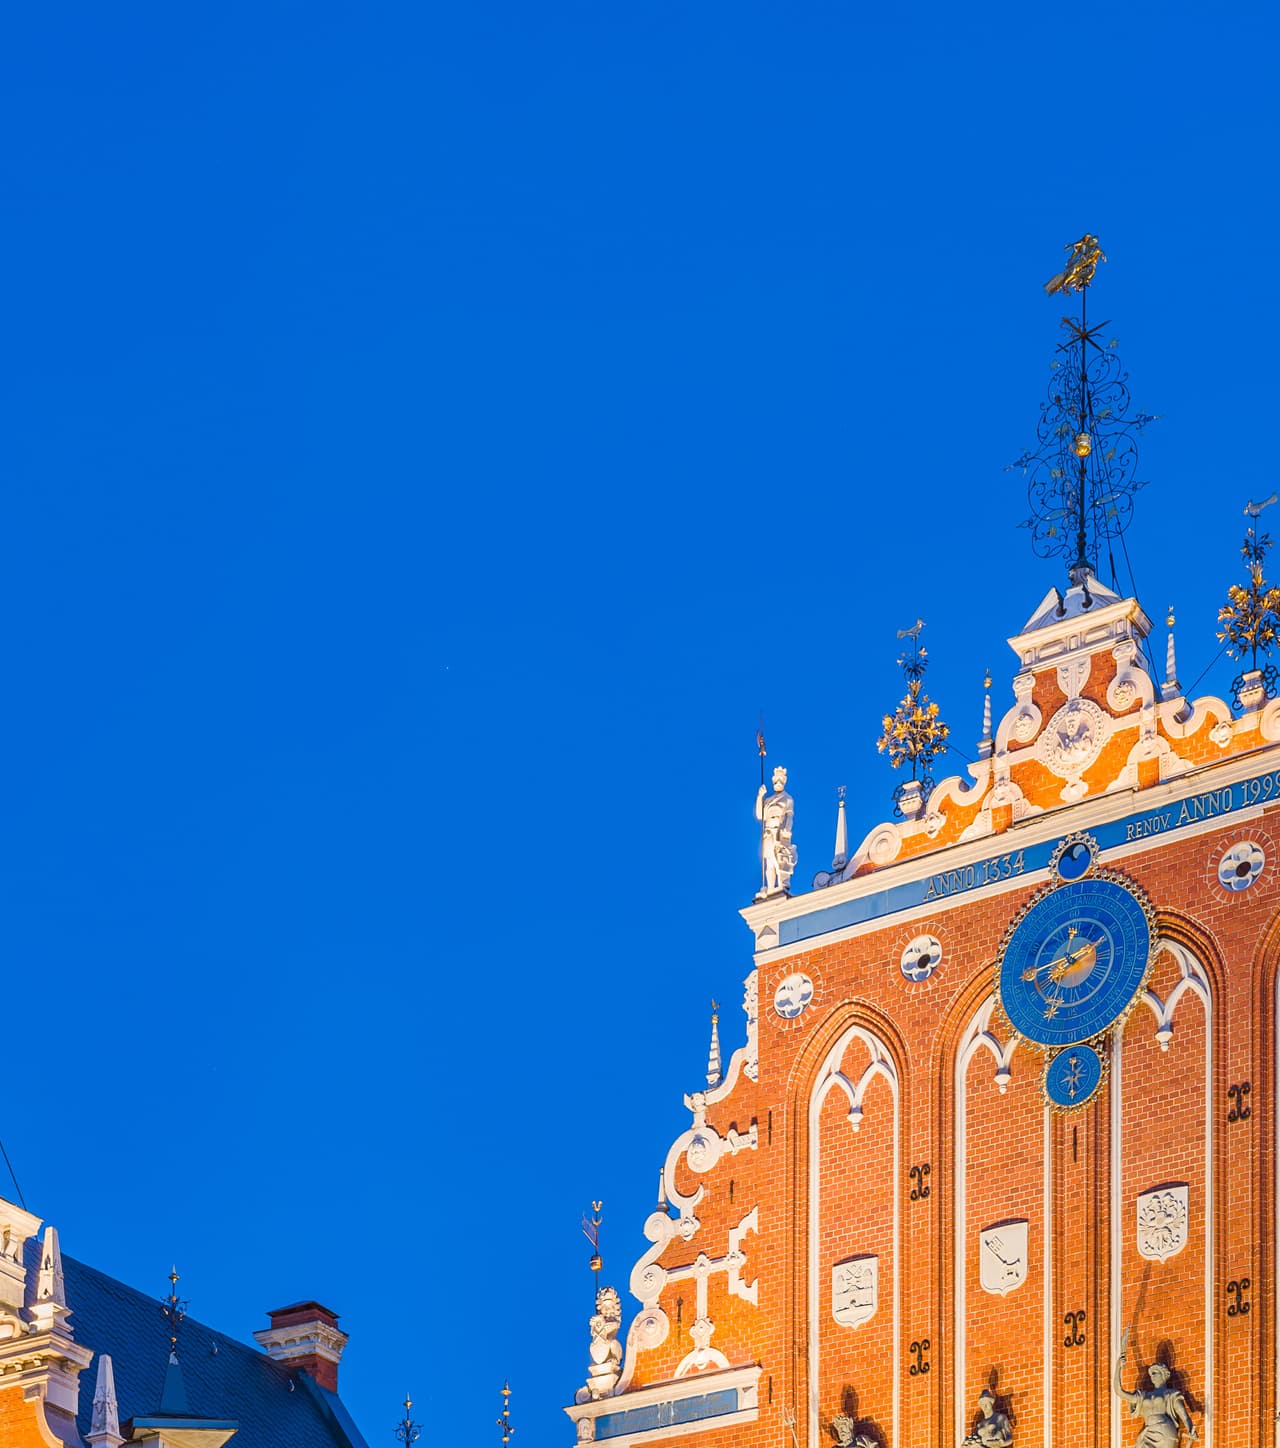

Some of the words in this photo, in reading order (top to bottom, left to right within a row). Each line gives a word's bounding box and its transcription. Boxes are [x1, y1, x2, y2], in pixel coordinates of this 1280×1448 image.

[924, 867, 975, 901] ANNO
[982, 850, 1026, 887] 1334
[1175, 787, 1233, 827] ANNO
